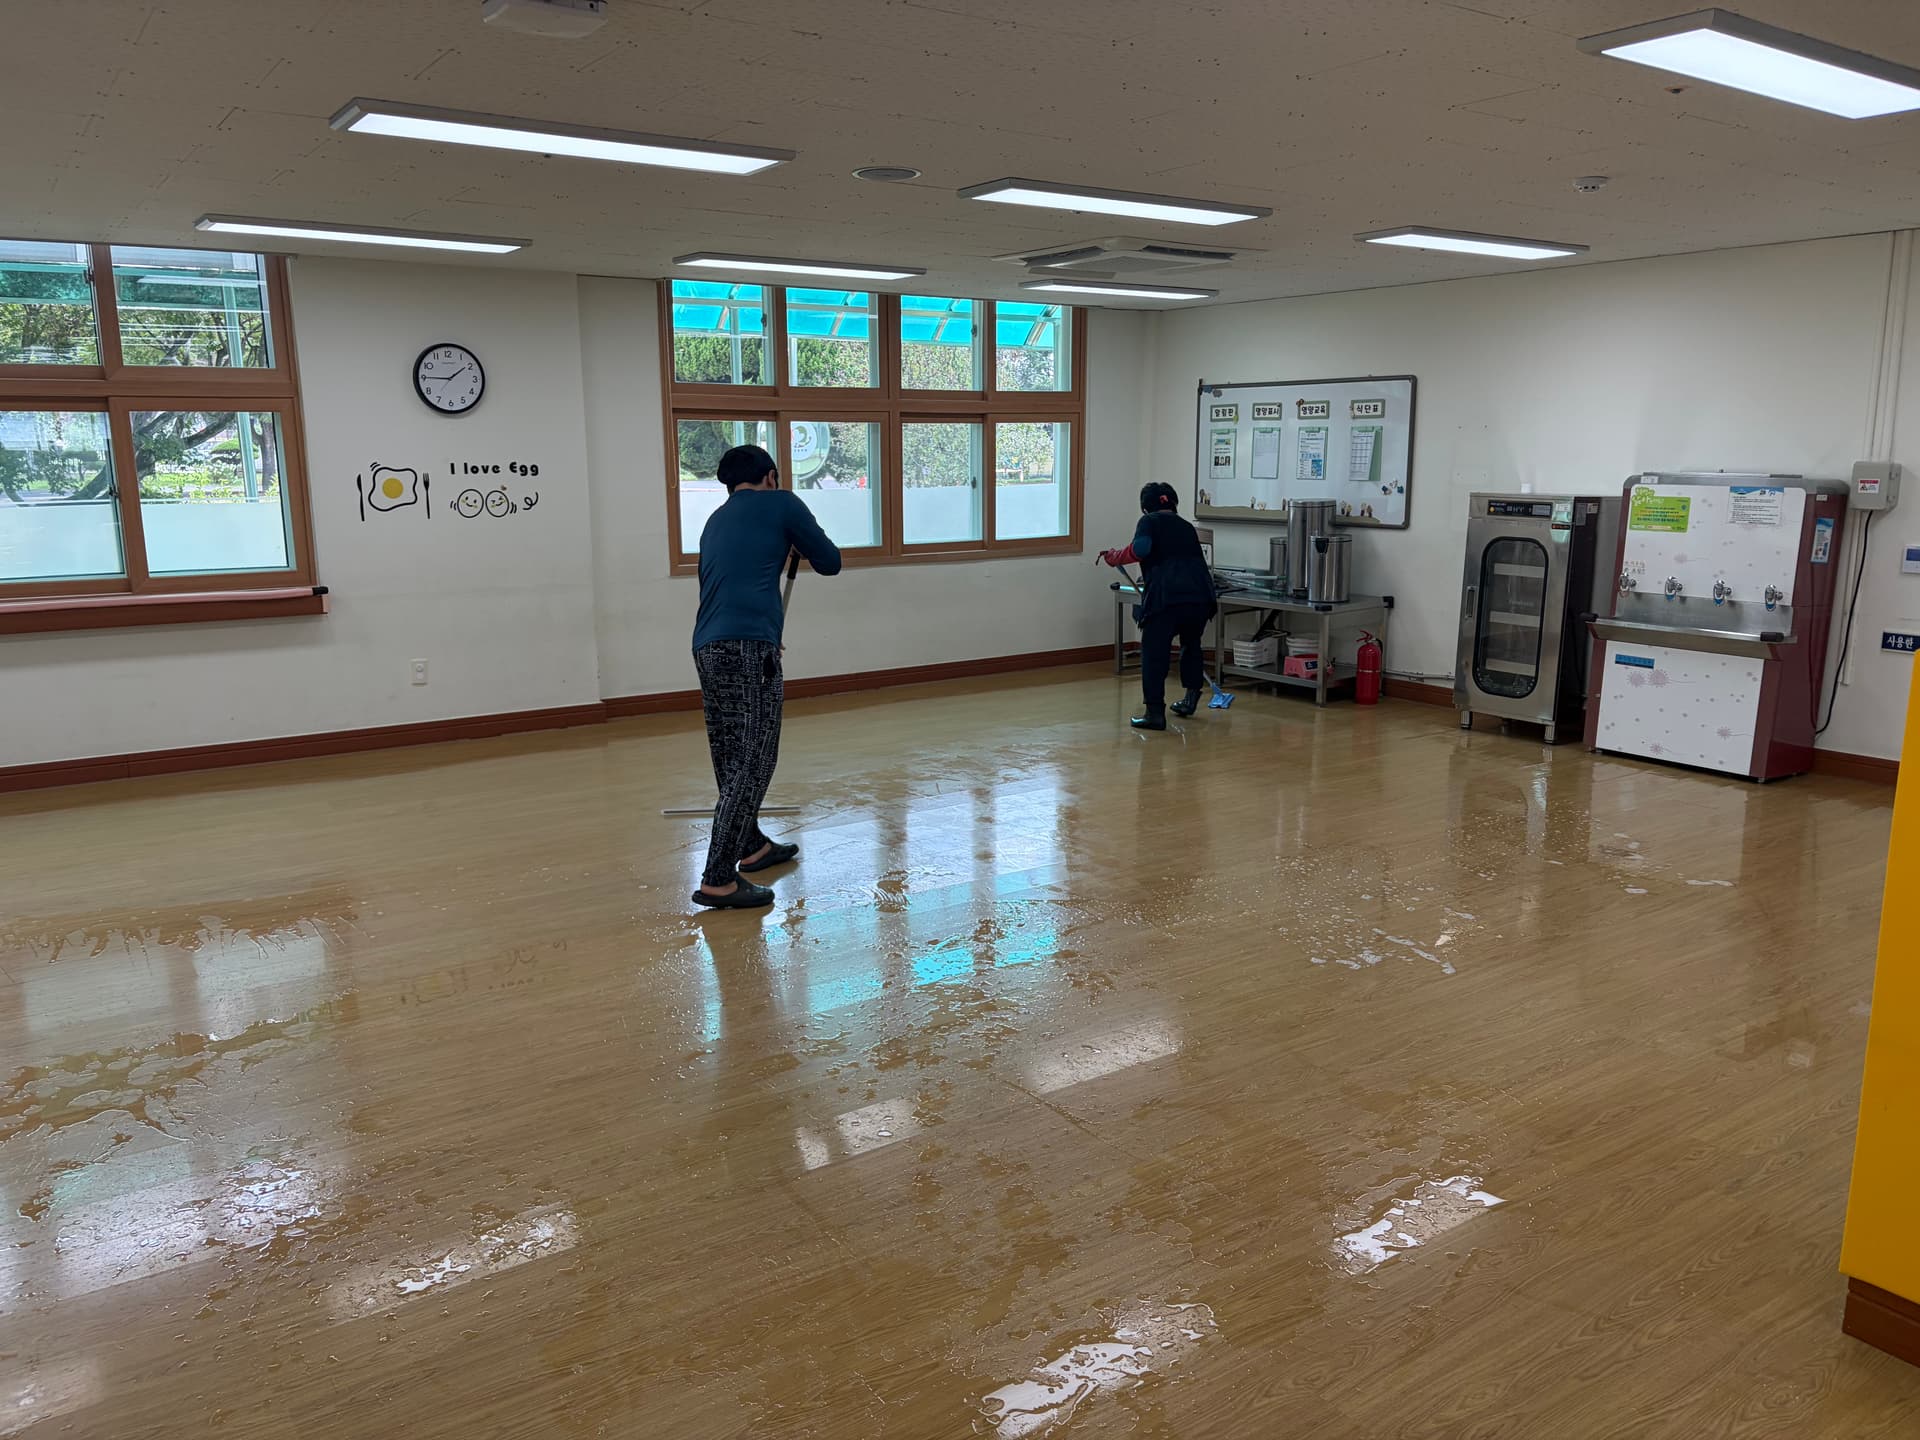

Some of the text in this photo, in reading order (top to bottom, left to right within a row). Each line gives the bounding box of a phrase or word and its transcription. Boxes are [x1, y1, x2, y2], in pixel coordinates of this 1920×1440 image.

[433, 352, 439, 360] 11
[444, 350, 452, 358] 12
[424, 362, 434, 370] 10
[467, 362, 473, 370] 2
[472, 375, 478, 383] 3
[426, 387, 432, 395] 8
[469, 387, 474, 395] 4
[460, 396, 466, 404] 5
[1214, 408, 1234, 417] 알림판
[1255, 407, 1280, 416] 영양표시
[1301, 405, 1326, 415] 영양교육
[1356, 404, 1379, 414] 식단표
[450, 461, 539, 476] I love Egg
[1886, 635, 1914, 650] 사용한
